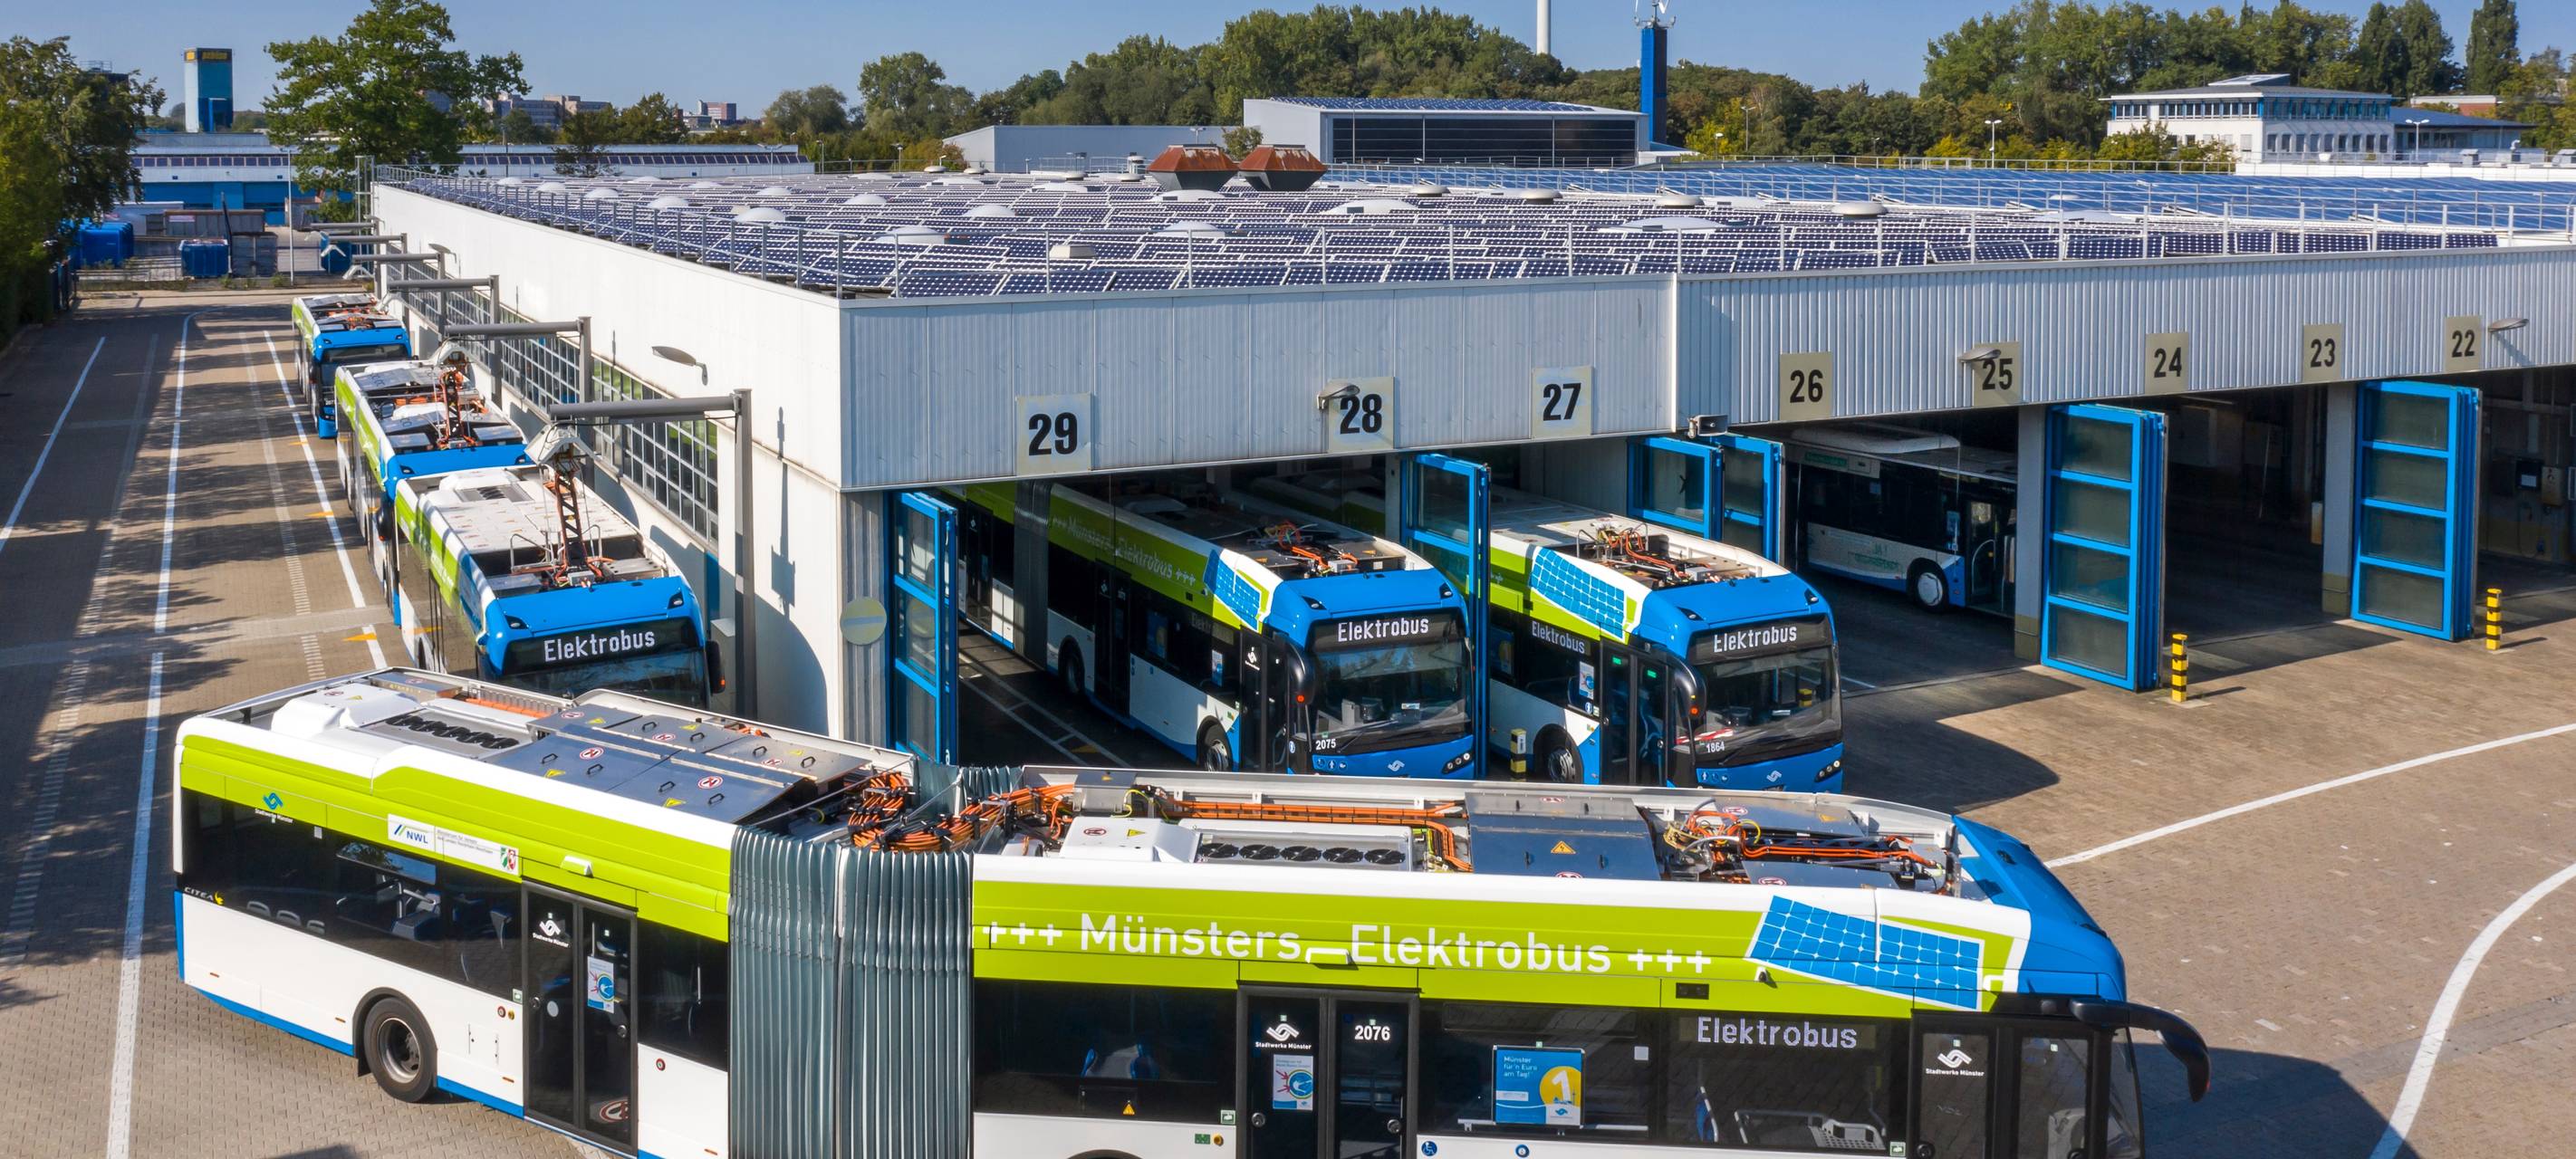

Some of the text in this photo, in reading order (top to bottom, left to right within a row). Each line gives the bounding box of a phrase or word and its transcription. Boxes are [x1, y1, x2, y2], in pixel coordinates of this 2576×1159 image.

[2310, 338, 2337, 368] 23
[2451, 329, 2476, 358] 22
[1981, 357, 2014, 390] 25
[2152, 347, 2183, 378] 24
[1789, 369, 1823, 404] 26
[1338, 393, 1382, 435] 28
[1542, 383, 1582, 422] 27
[1027, 411, 1079, 456] 29
[1117, 535, 1173, 580] Elektrobus
[1338, 617, 1429, 642] Elektrobus
[1532, 620, 1585, 654] Elektrobus
[1714, 626, 1797, 653] Elektrobus
[543, 629, 655, 662] Elektrobus
[1315, 738, 1336, 751] 2075
[1706, 741, 1725, 753] 1864
[406, 830, 428, 844] NWL
[184, 886, 214, 901] CITEA
[1081, 913, 1301, 960] Münsters
[1350, 924, 1611, 972] Elektrobus
[1254, 1041, 1312, 1050] Stadtwerke Münster
[1354, 1025, 1391, 1041] 2076
[1697, 1016, 1857, 1049] Elektrobus
[1504, 1056, 1532, 1064] Münster
[1926, 1068, 1985, 1078] Stadtwerke Münster
[1552, 1070, 1572, 1103] 1
